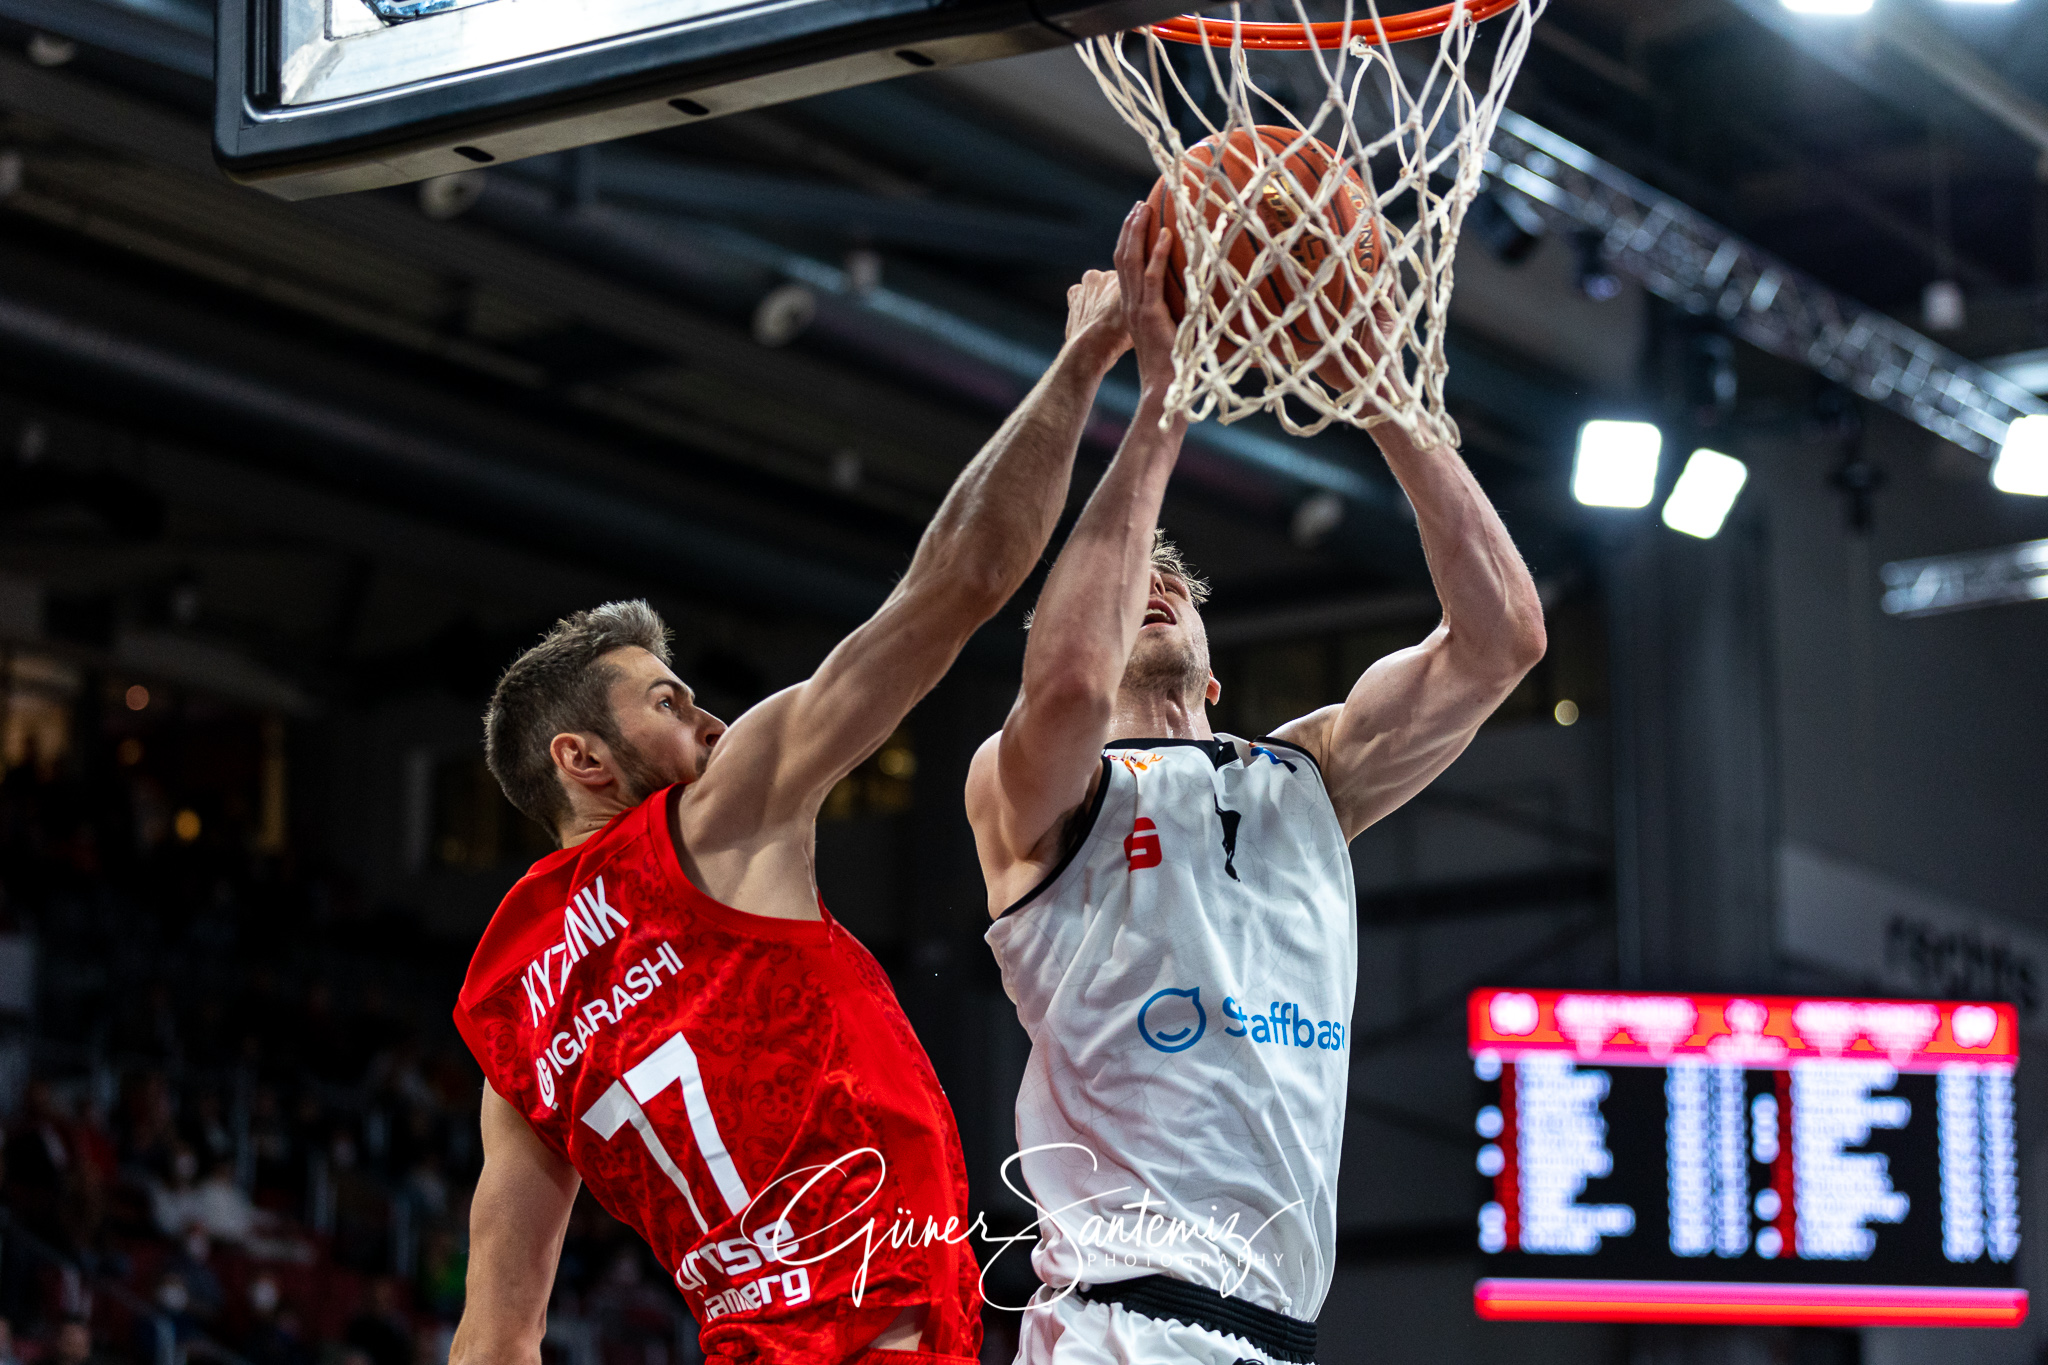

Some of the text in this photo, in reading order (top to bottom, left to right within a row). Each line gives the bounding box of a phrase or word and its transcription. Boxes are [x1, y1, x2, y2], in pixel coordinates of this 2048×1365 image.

[520, 875, 630, 1029] KYZINK
[544, 940, 685, 1077] IGARASHI
[1222, 996, 1346, 1051] Staffbas
[580, 1030, 752, 1235] 17
